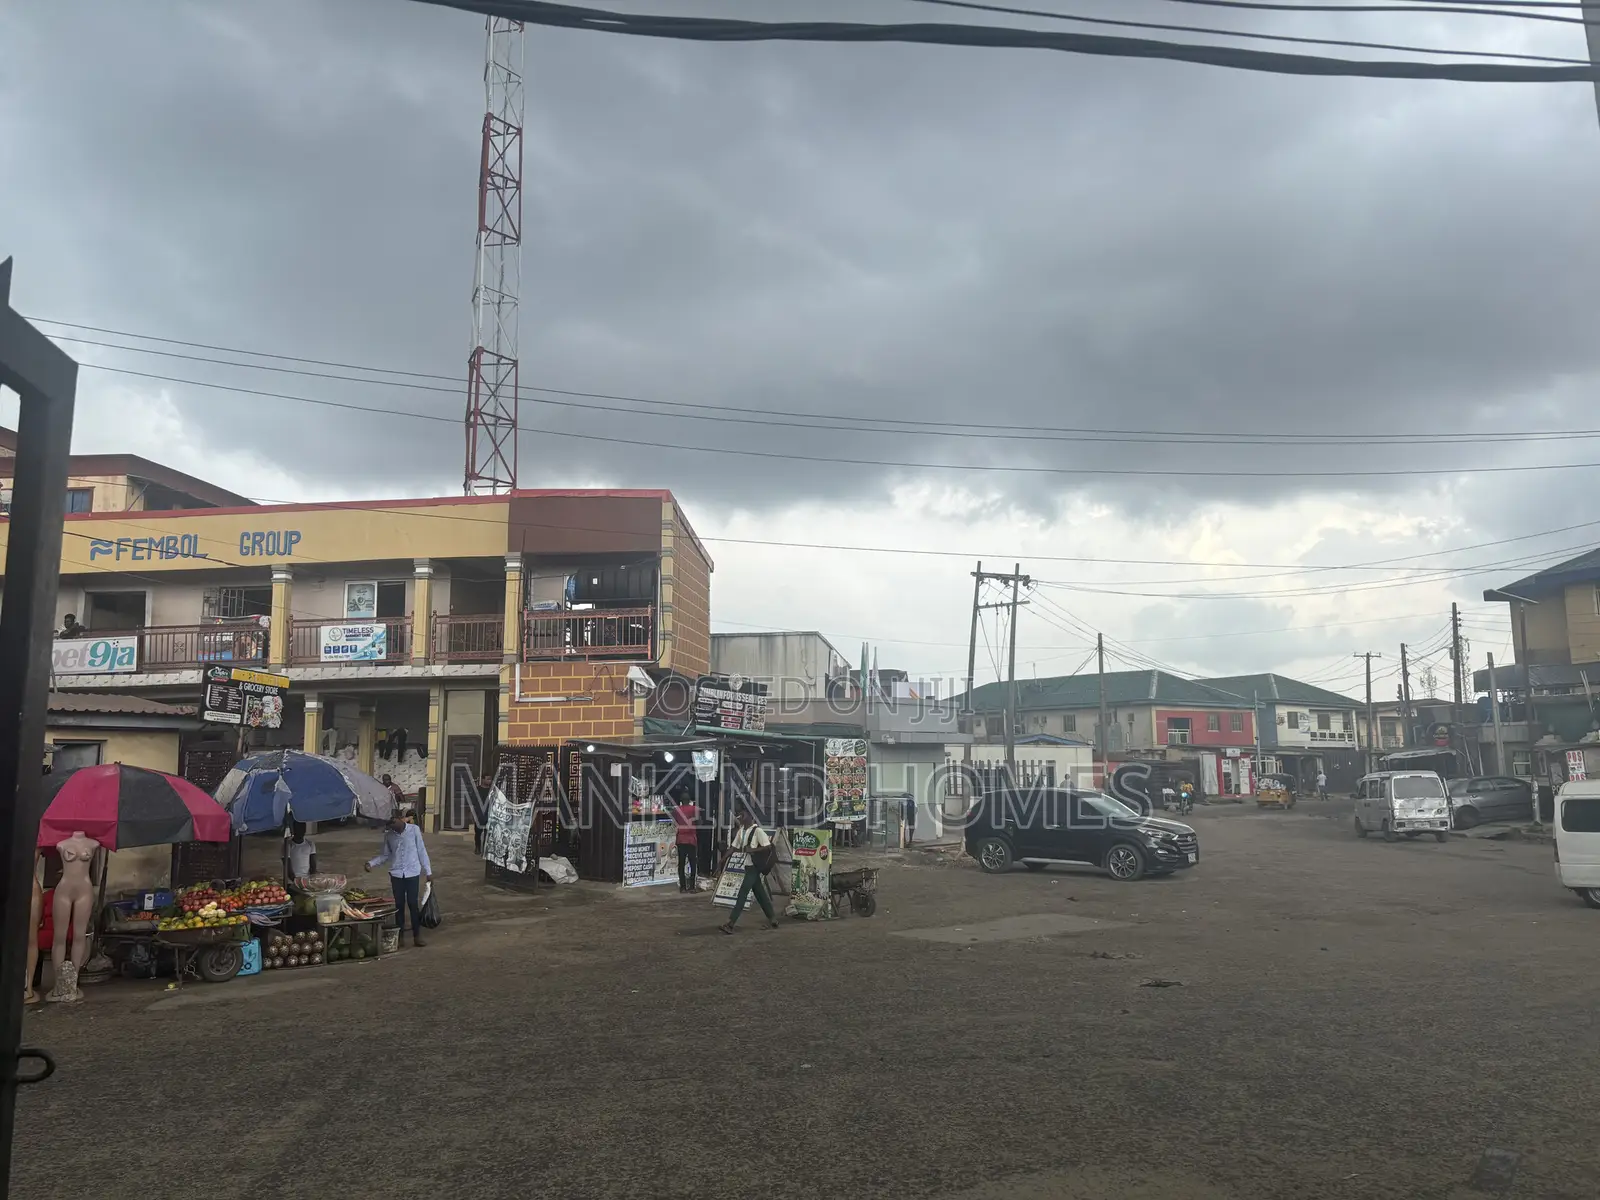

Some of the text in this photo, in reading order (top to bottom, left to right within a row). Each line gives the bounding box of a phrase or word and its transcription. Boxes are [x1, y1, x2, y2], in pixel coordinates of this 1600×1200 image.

[115, 530, 302, 561] FEMBOL GROUP
[342, 626, 375, 634] TIMELESS
[243, 682, 266, 694] GROCERY
[264, 686, 279, 696] STORE
[1567, 751, 1583, 762] POS
